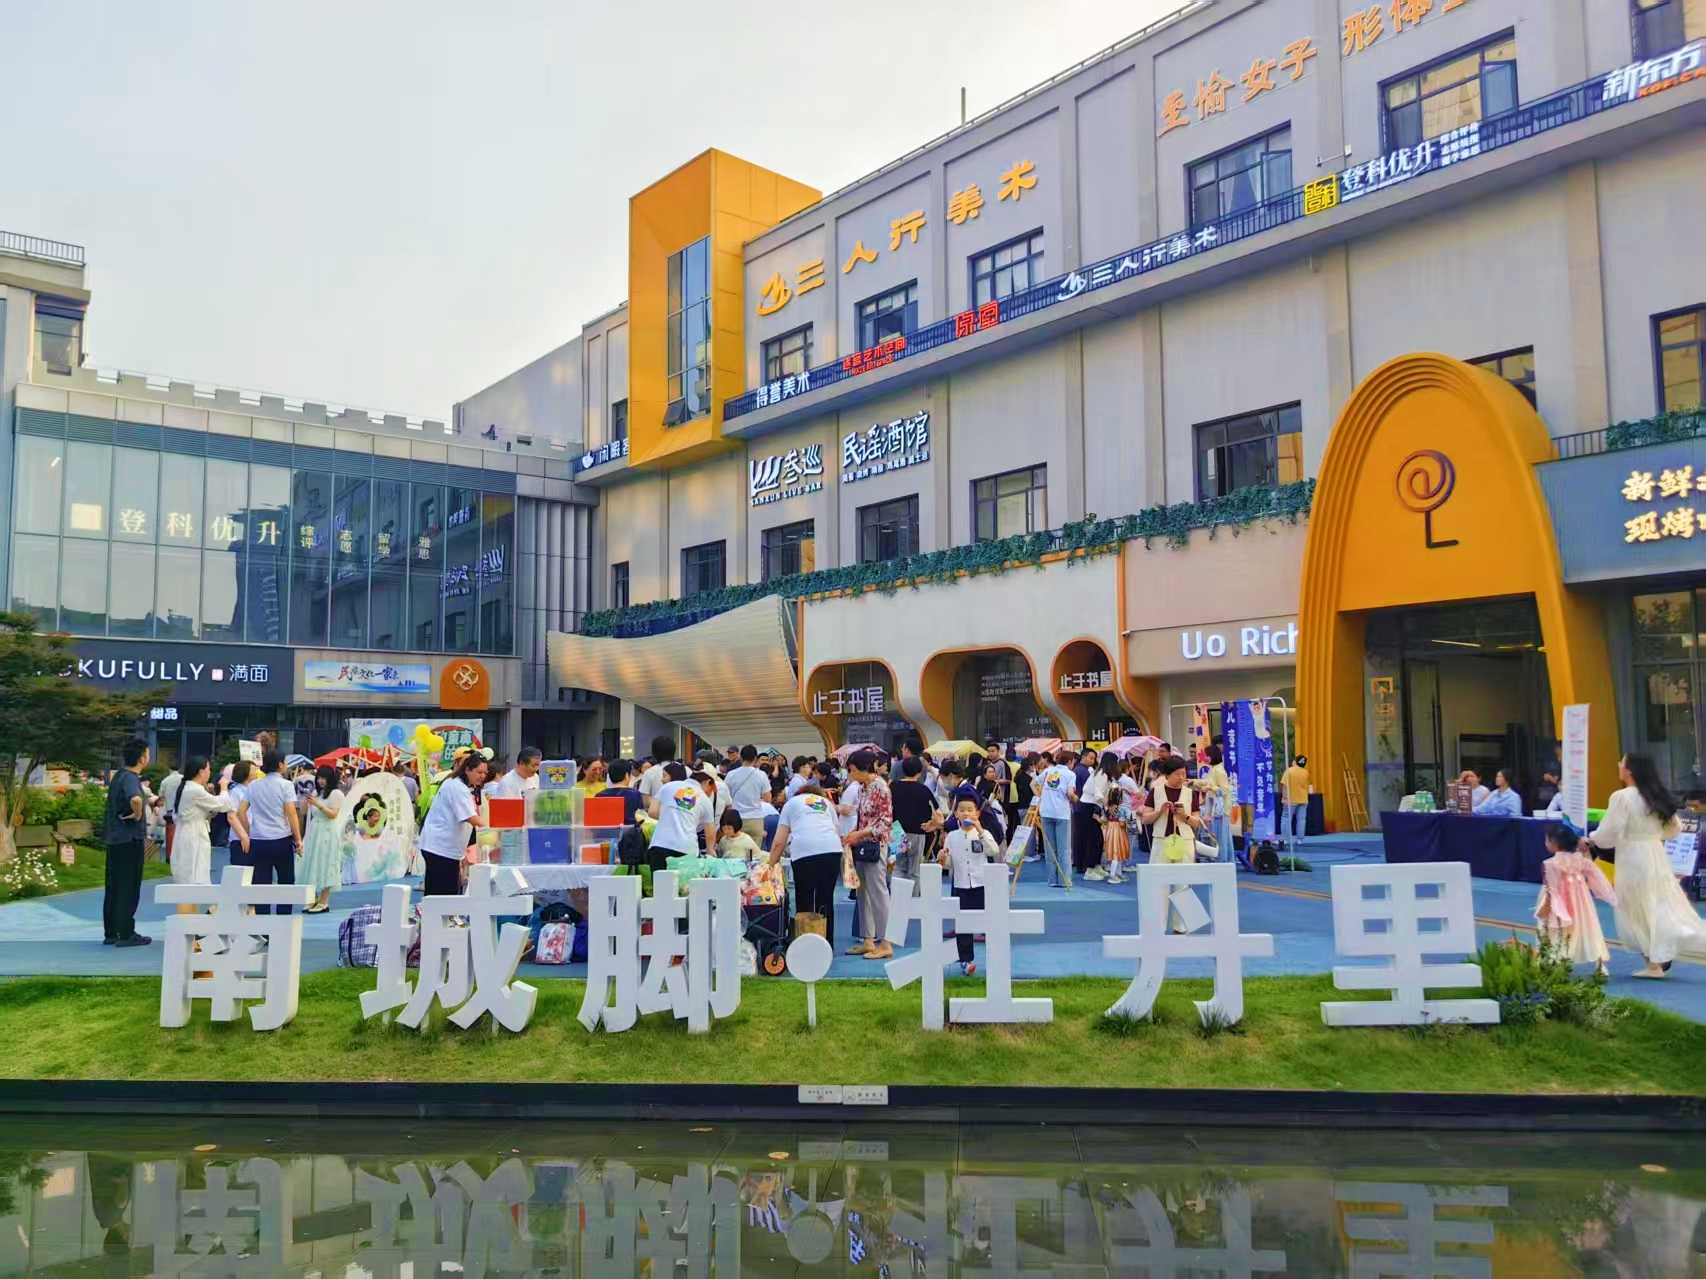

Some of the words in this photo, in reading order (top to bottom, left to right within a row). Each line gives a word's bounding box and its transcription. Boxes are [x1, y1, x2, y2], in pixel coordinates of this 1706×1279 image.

[1342, 0, 1470, 56] 形体
[1156, 38, 1318, 137] 至愉女子
[1602, 43, 1702, 101] 新东方
[1341, 139, 1438, 191] 登科优升
[793, 160, 1038, 297] 三人行美术
[1091, 225, 1218, 285] 三人行美术
[755, 371, 811, 409] 得誉美术
[841, 410, 931, 468] 民谣酒馆
[118, 508, 281, 546] 登科优升
[37, 658, 205, 682] KUFULLY
[1182, 630, 1227, 660] Uo
[812, 686, 884, 716] 止于书屋
[1060, 670, 1113, 690] 止于书屋
